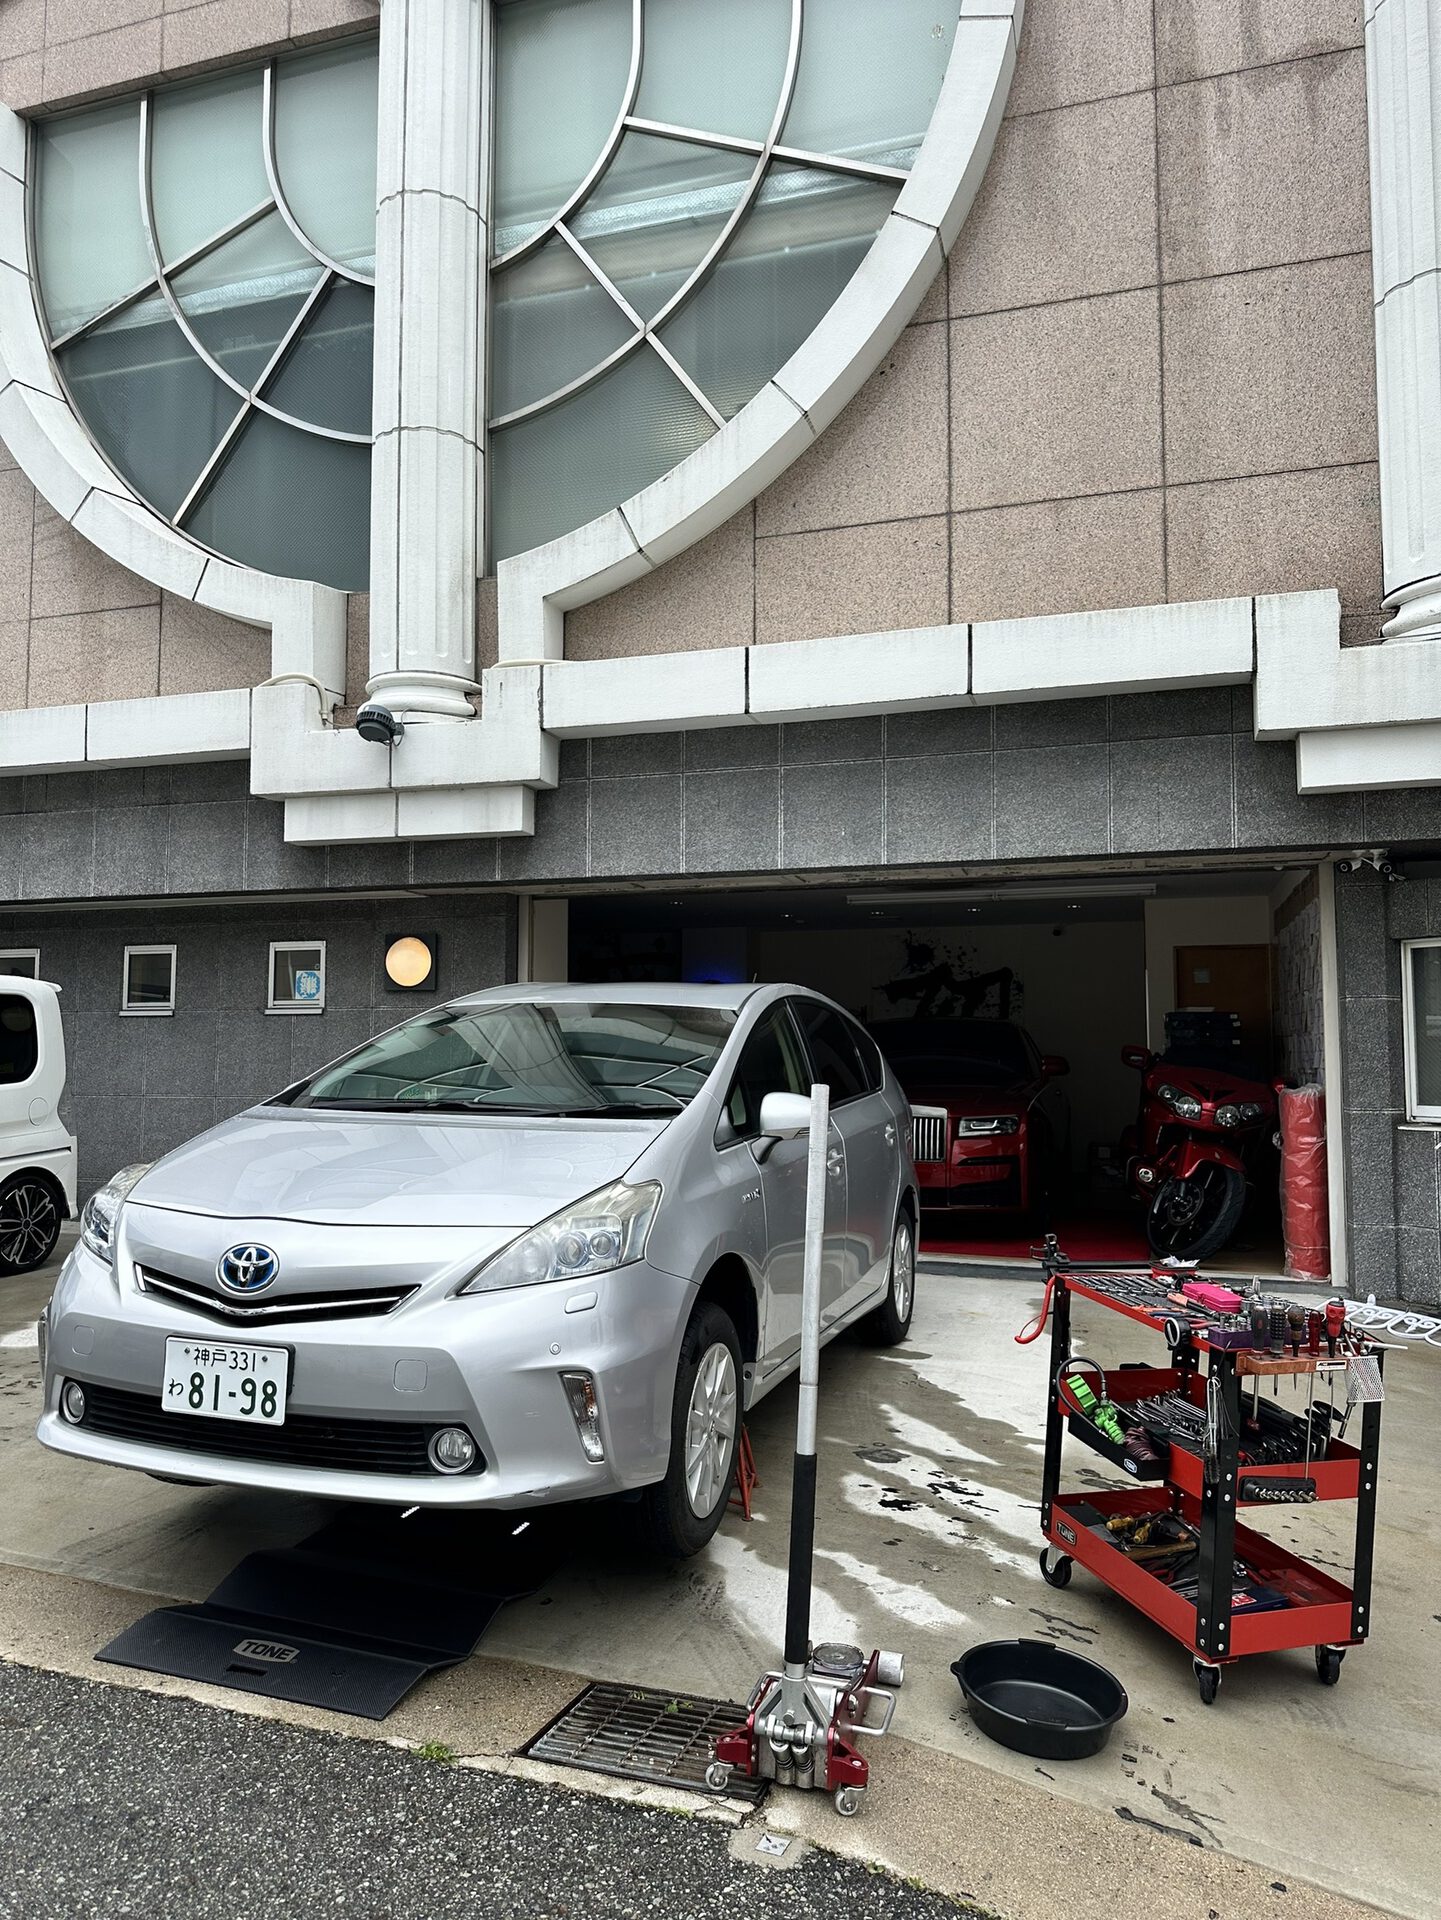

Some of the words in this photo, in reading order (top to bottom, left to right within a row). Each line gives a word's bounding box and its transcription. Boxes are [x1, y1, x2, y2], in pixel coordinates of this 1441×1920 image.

[168, 1378, 184, 1396] わ
[188, 1372, 278, 1418] 81-98
[1057, 1523, 1075, 1543] TONE
[242, 1641, 294, 1660] TONE
